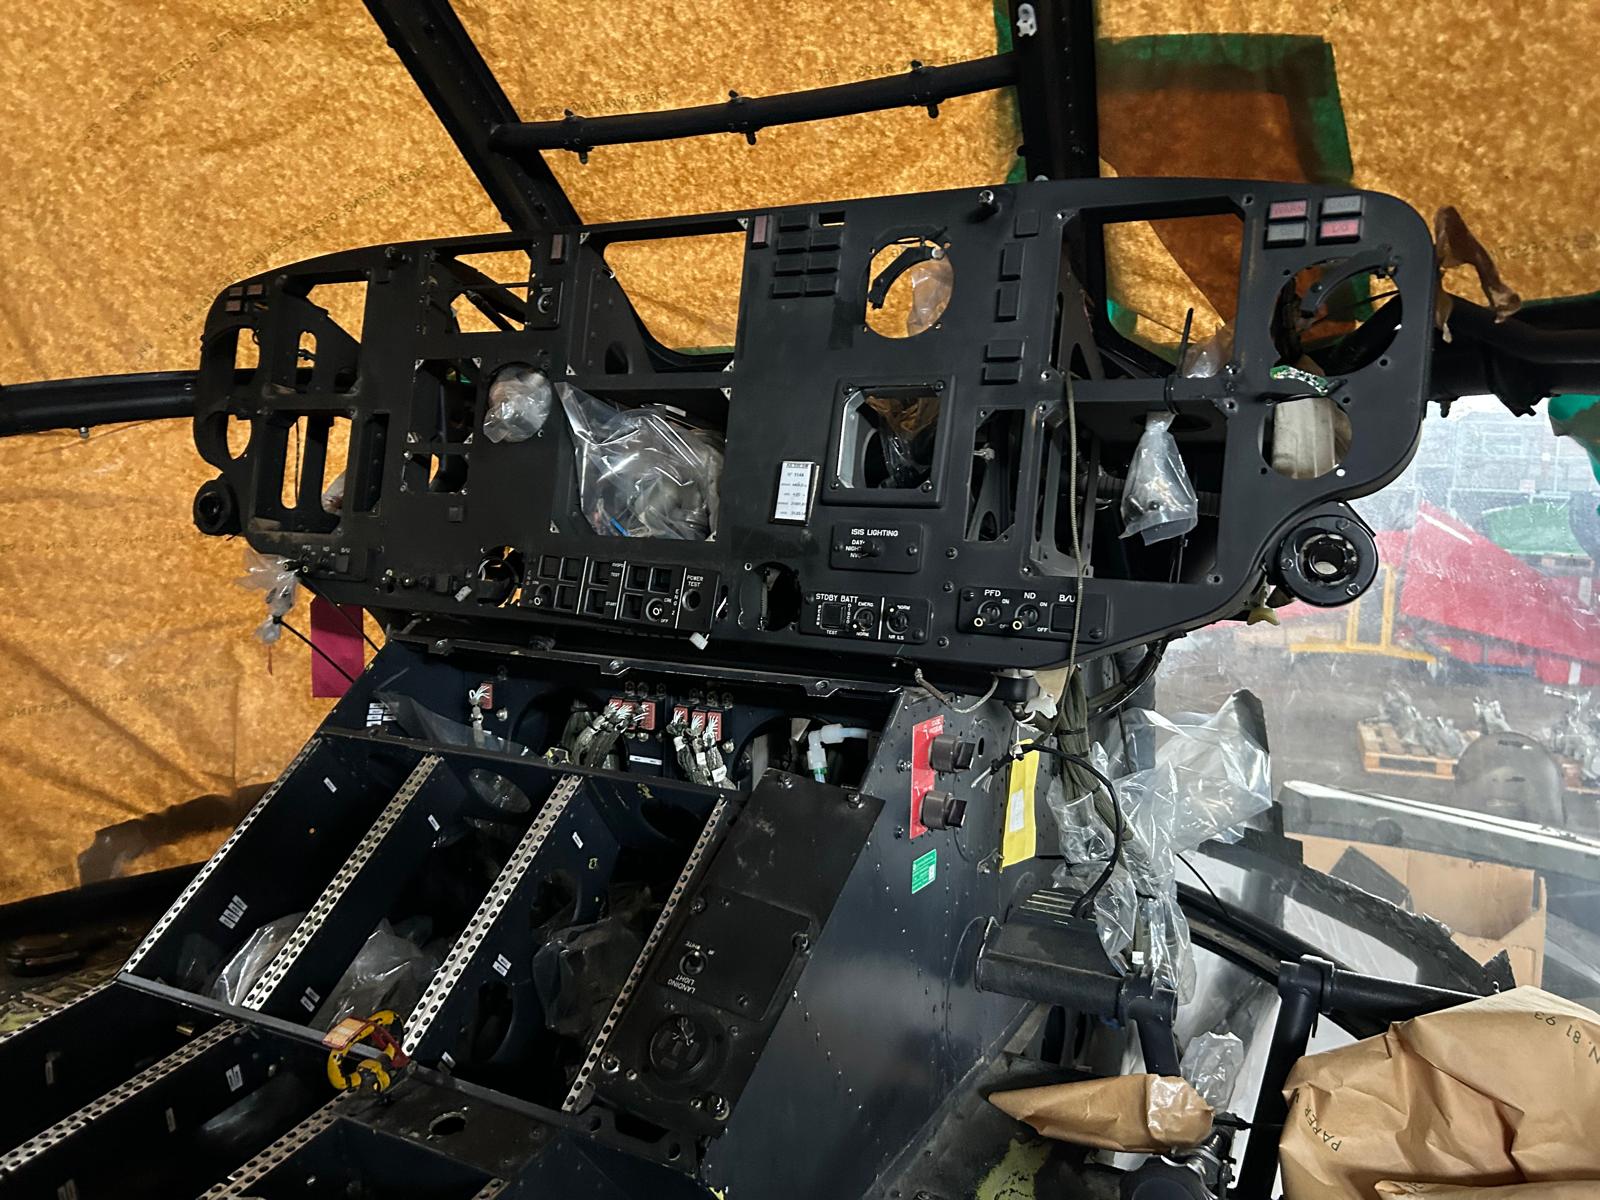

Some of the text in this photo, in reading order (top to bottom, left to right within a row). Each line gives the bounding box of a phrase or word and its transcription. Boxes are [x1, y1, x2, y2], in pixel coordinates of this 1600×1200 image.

[840, 595, 859, 603] BATT
[1059, 594, 1075, 602] B/U
[667, 978, 696, 994] LANDING
[675, 974, 695, 986] LIGHT
[1534, 1011, 1556, 1026] 93
[1566, 1024, 1581, 1044] 81
[1304, 1104, 1342, 1152] PAPER
